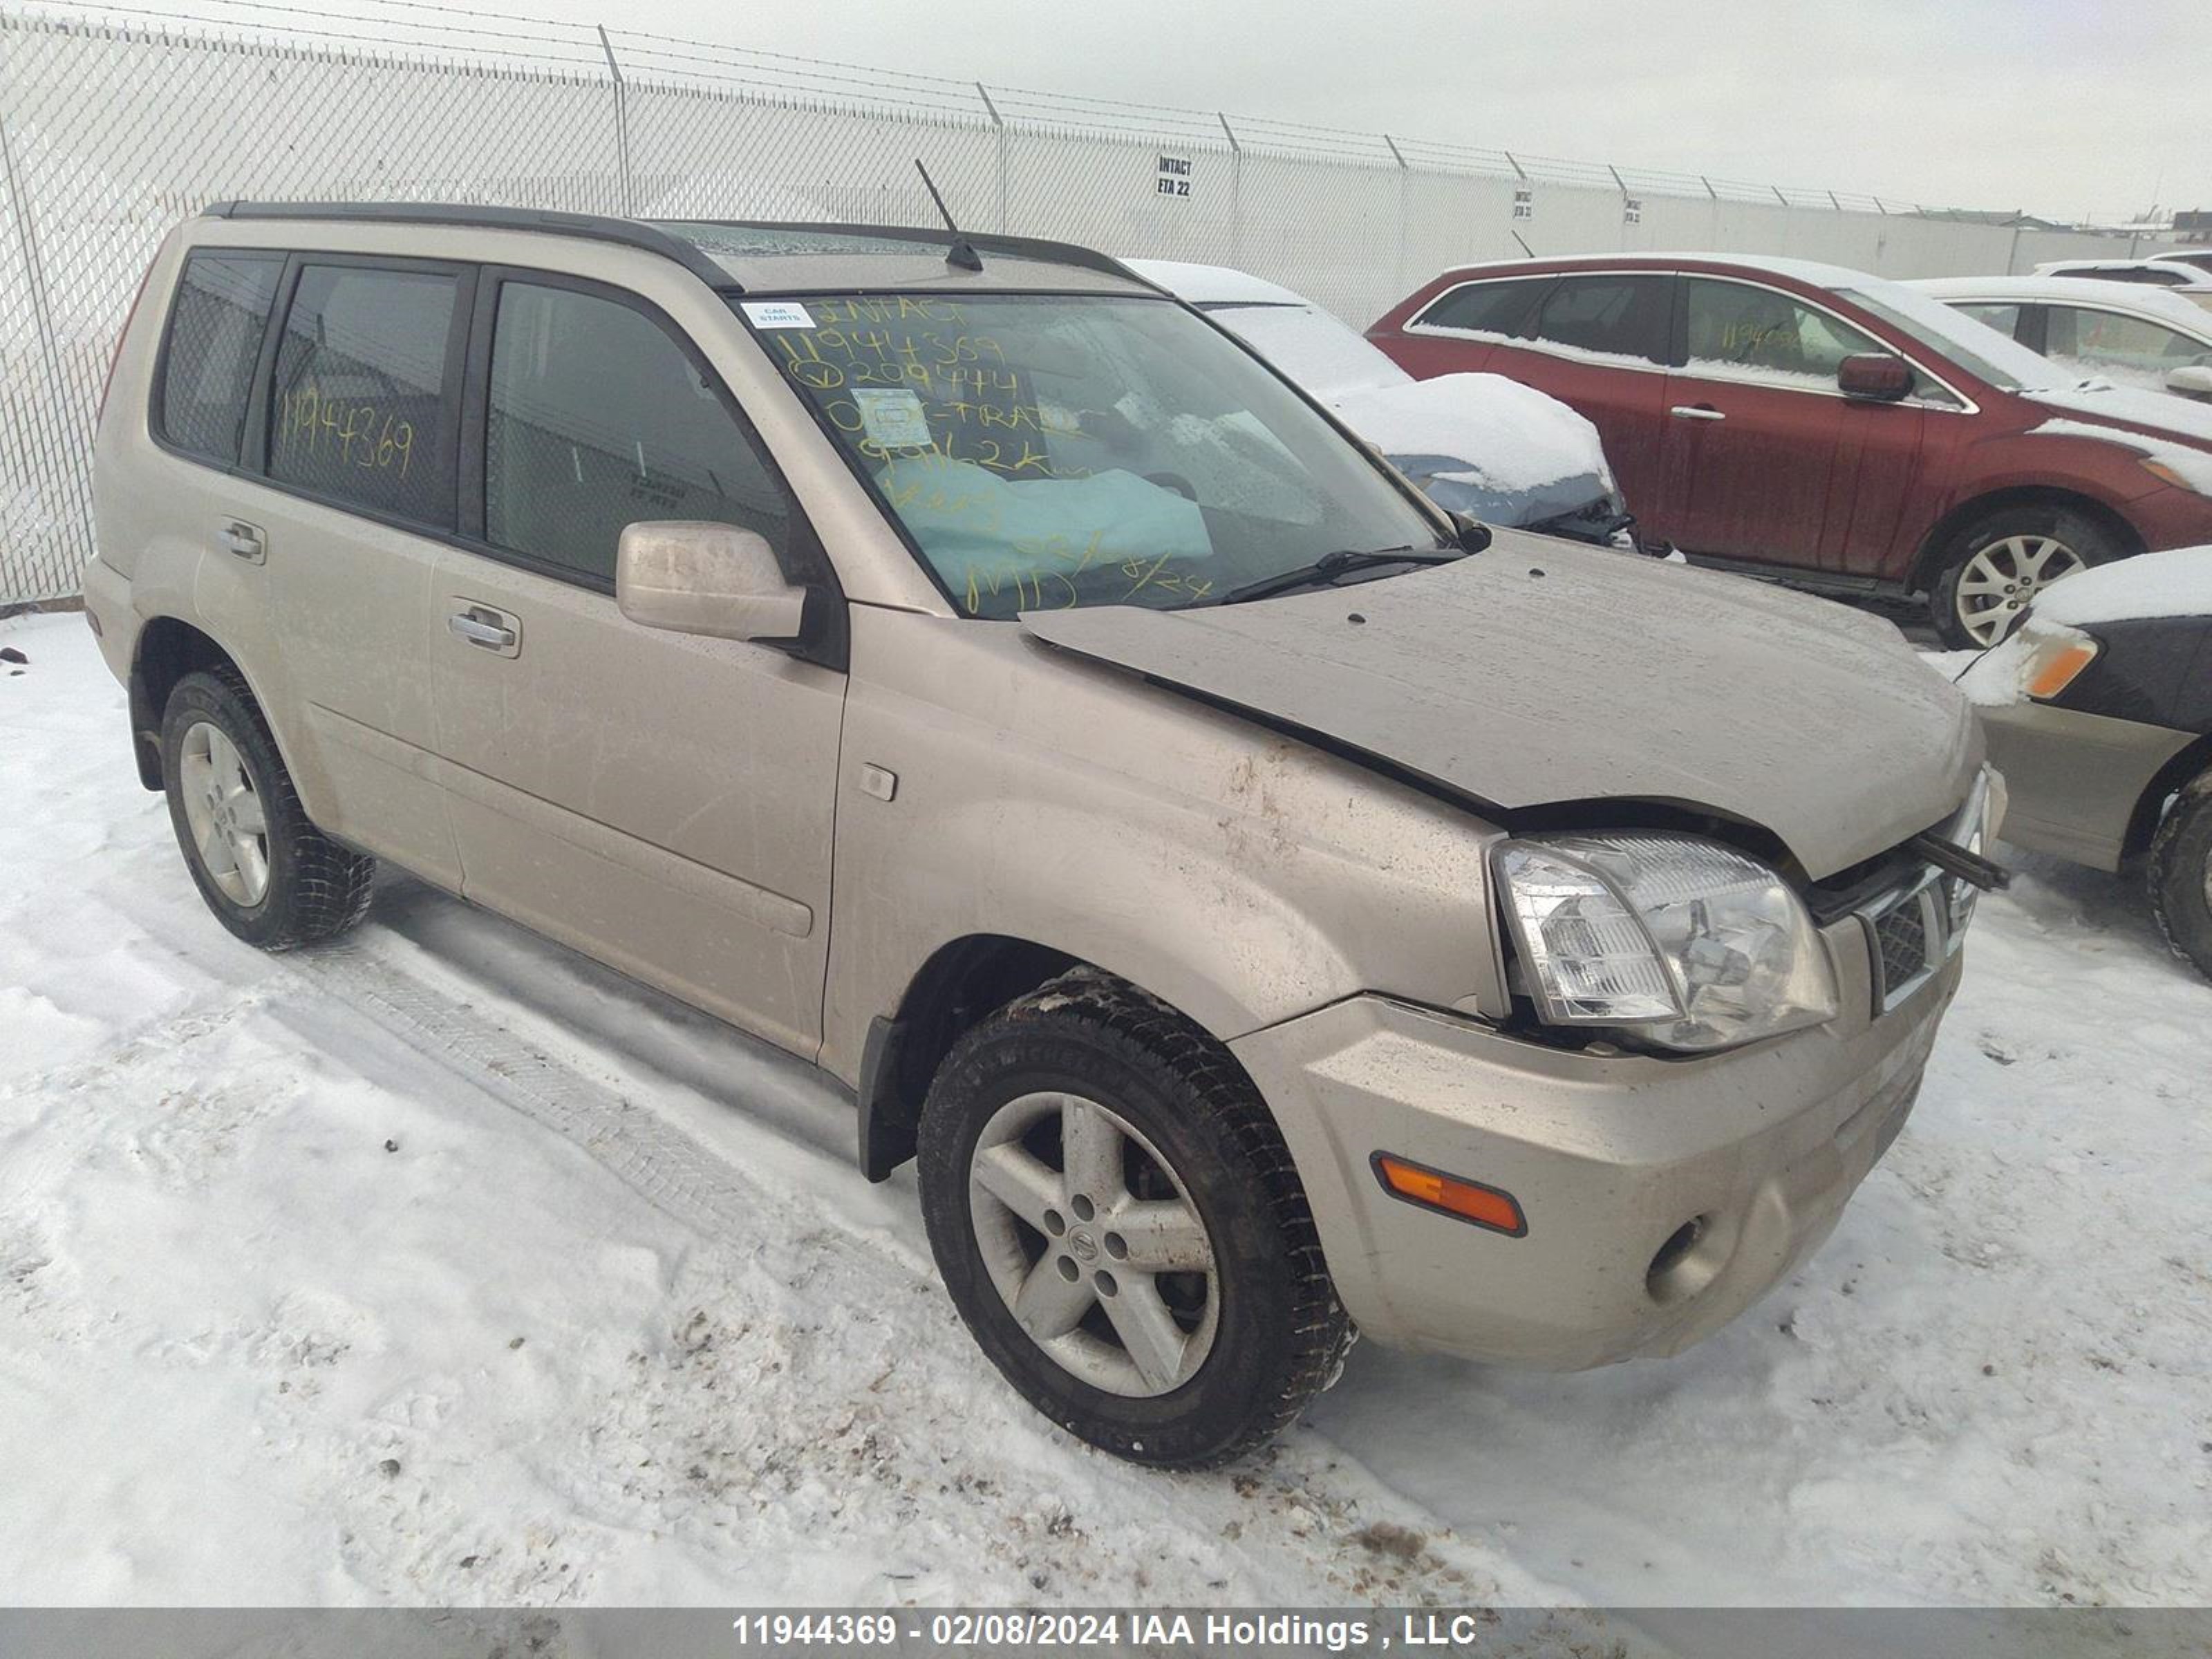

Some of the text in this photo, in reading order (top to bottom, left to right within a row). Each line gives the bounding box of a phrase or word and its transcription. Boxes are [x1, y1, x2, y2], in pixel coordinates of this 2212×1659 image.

[1159, 155, 1192, 176] INTACT
[1158, 178, 1190, 196] ETA 22
[817, 298, 967, 327] INTACT
[280, 386, 412, 478] 11944369
